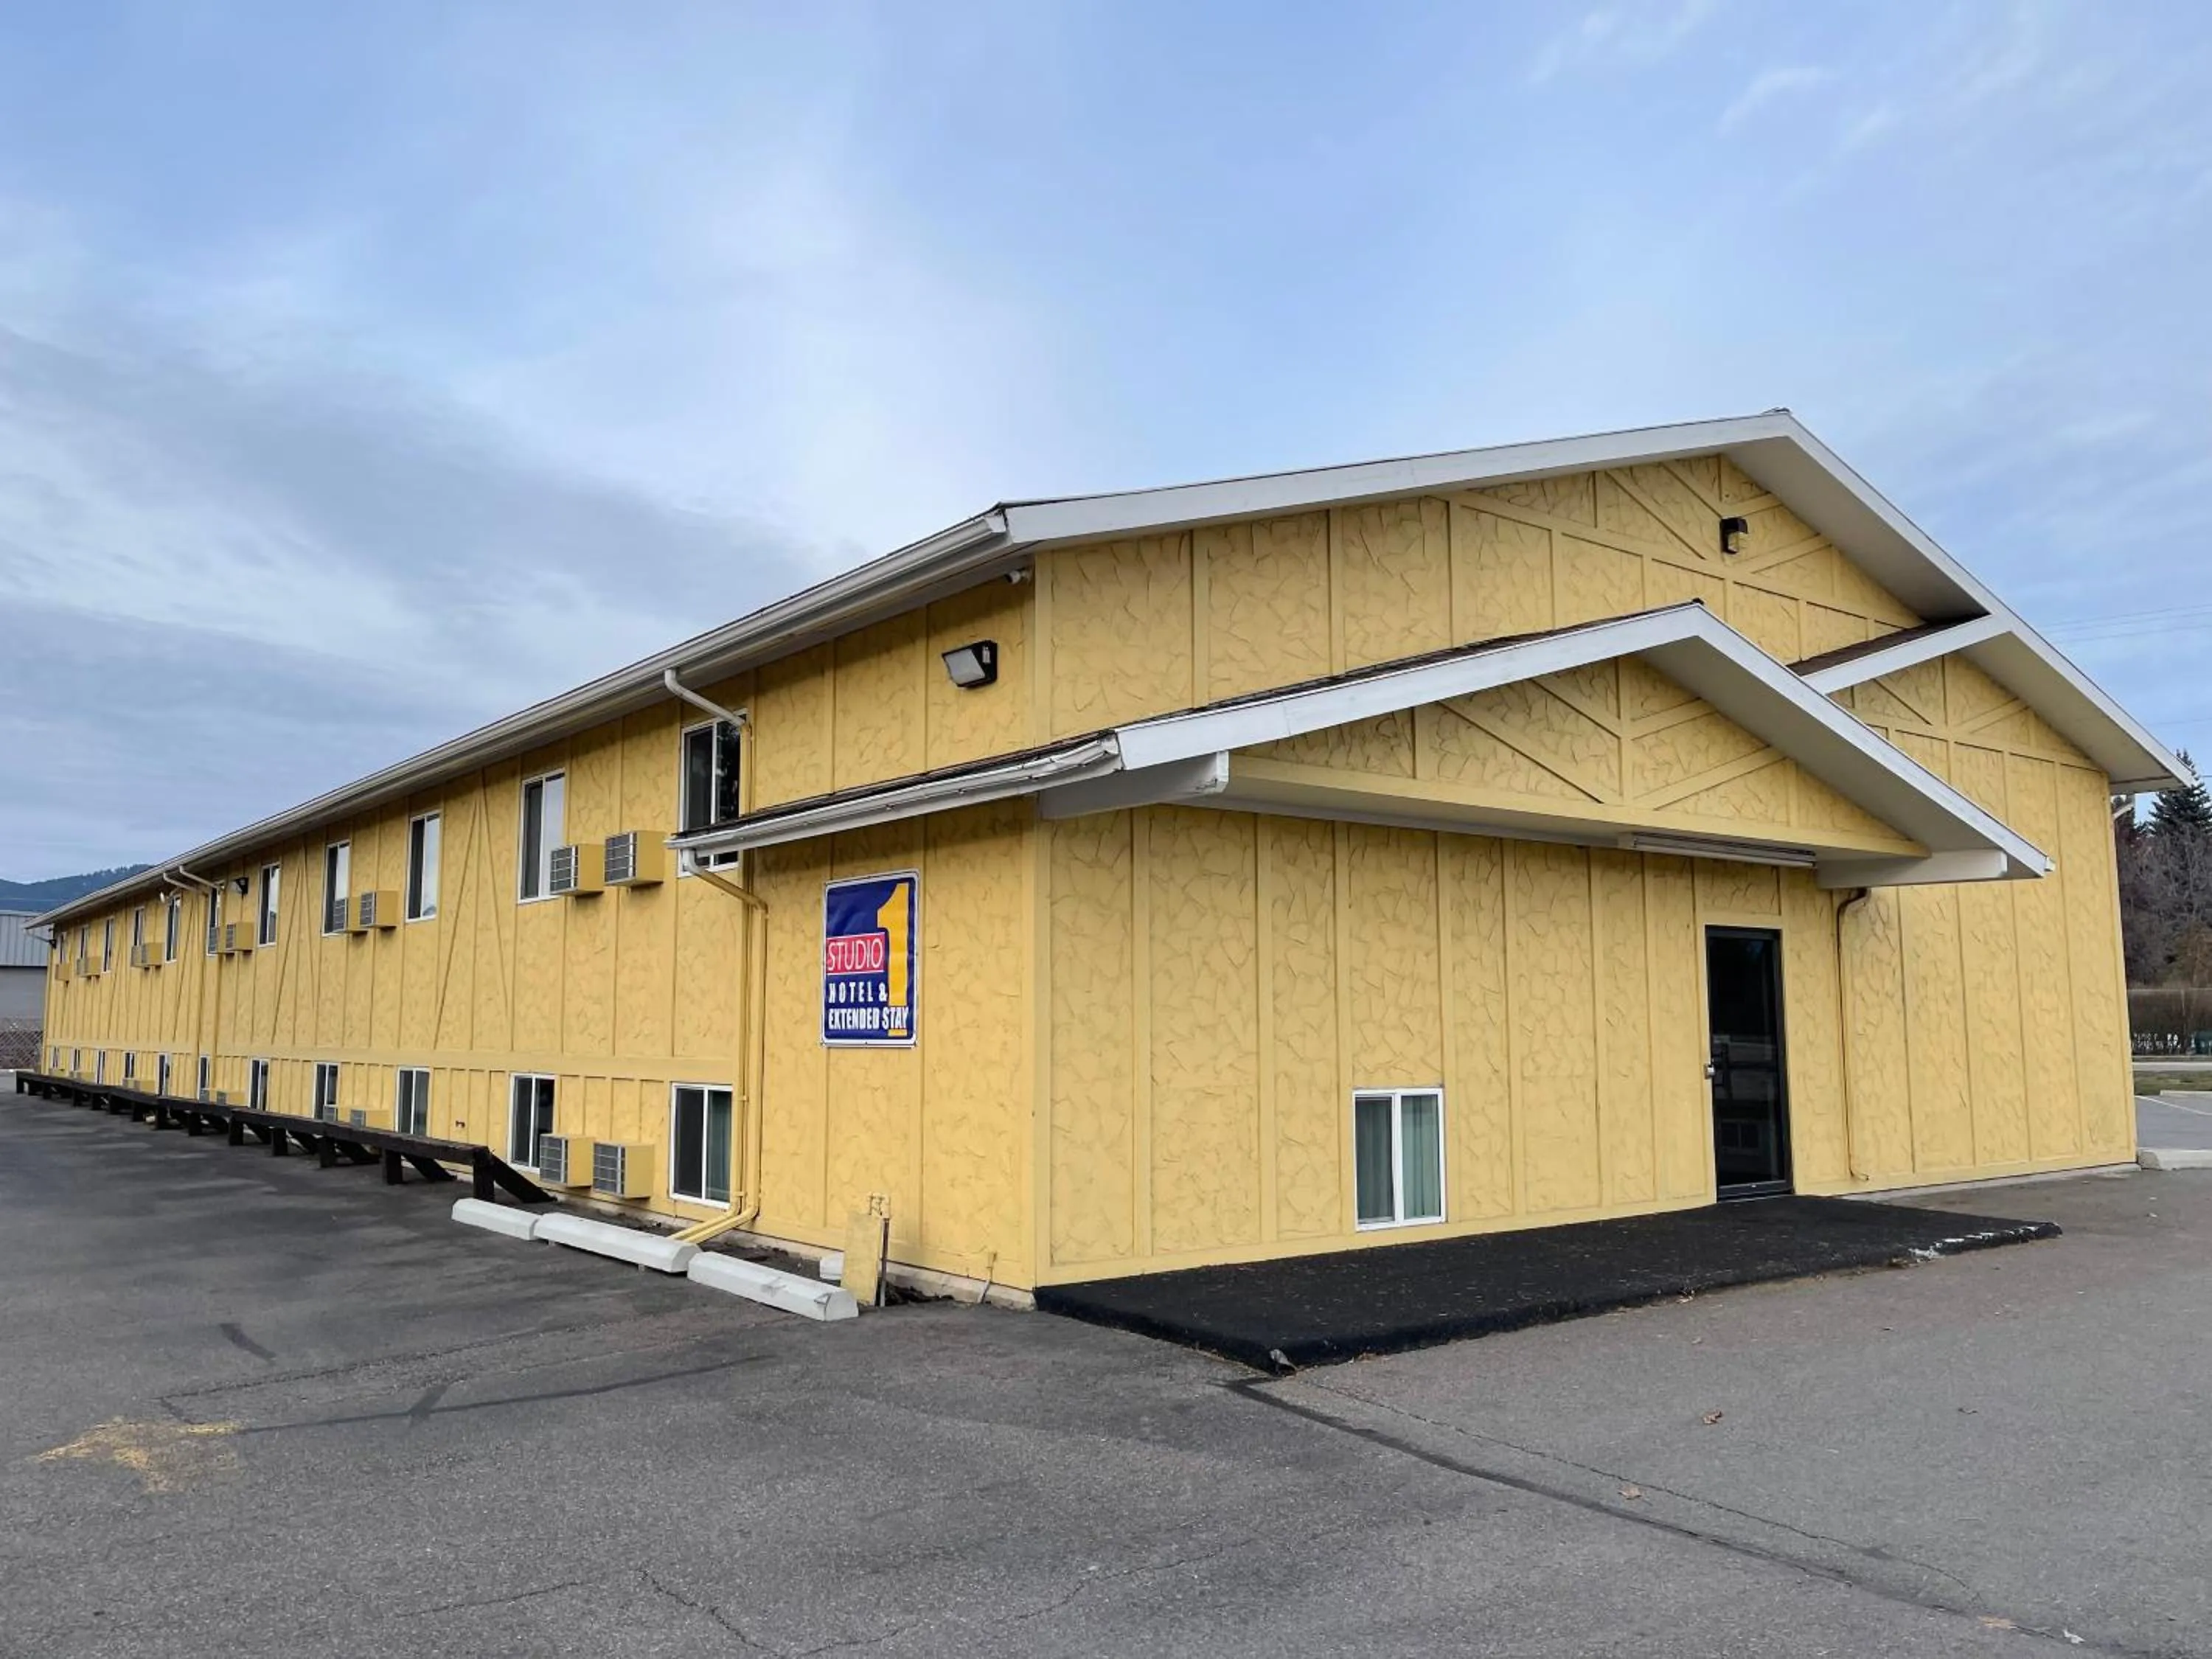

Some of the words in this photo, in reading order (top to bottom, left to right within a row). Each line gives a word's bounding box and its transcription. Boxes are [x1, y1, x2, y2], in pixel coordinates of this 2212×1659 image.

[827, 939, 883, 971] STUDIO
[877, 883, 909, 1036] 1
[829, 981, 873, 1004] HOTEL
[879, 981, 888, 1002] &
[828, 1007, 880, 1029] EXTENDED
[882, 1006, 908, 1029] STAY
